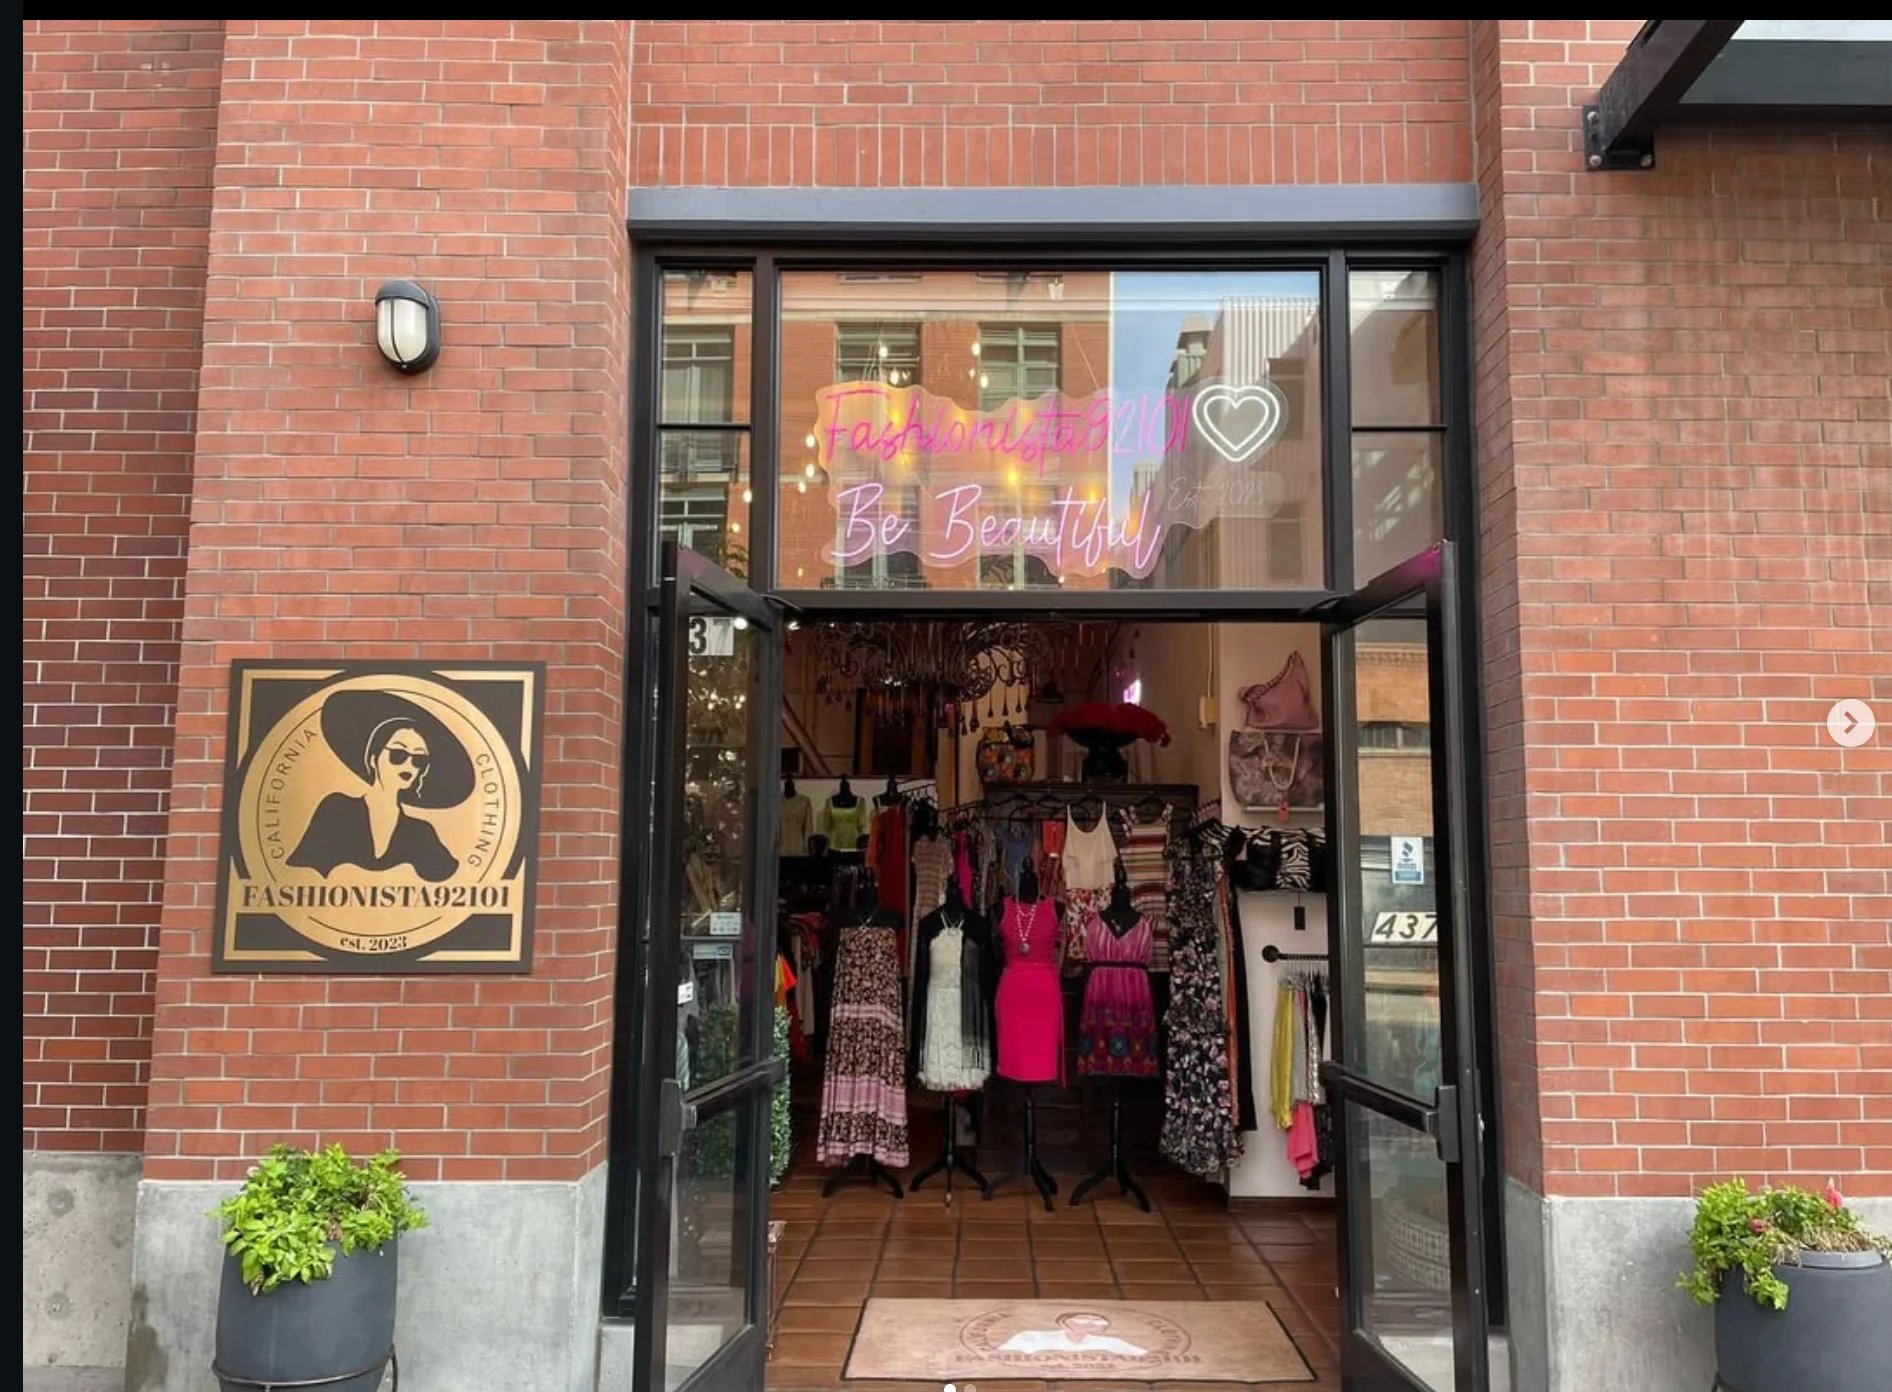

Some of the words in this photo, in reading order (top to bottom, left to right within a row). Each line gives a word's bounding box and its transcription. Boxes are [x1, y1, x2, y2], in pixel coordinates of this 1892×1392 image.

[823, 387, 1191, 476] Fashionista92101
[830, 482, 909, 558] Be
[929, 484, 1162, 570] Beautiful
[264, 727, 317, 859] CALIFORNIA
[467, 752, 498, 868] CLOTHING
[242, 885, 510, 908] FASHIONISTA92101
[1375, 913, 1438, 939] 437
[339, 934, 366, 950] est.
[368, 934, 408, 952] 2023
